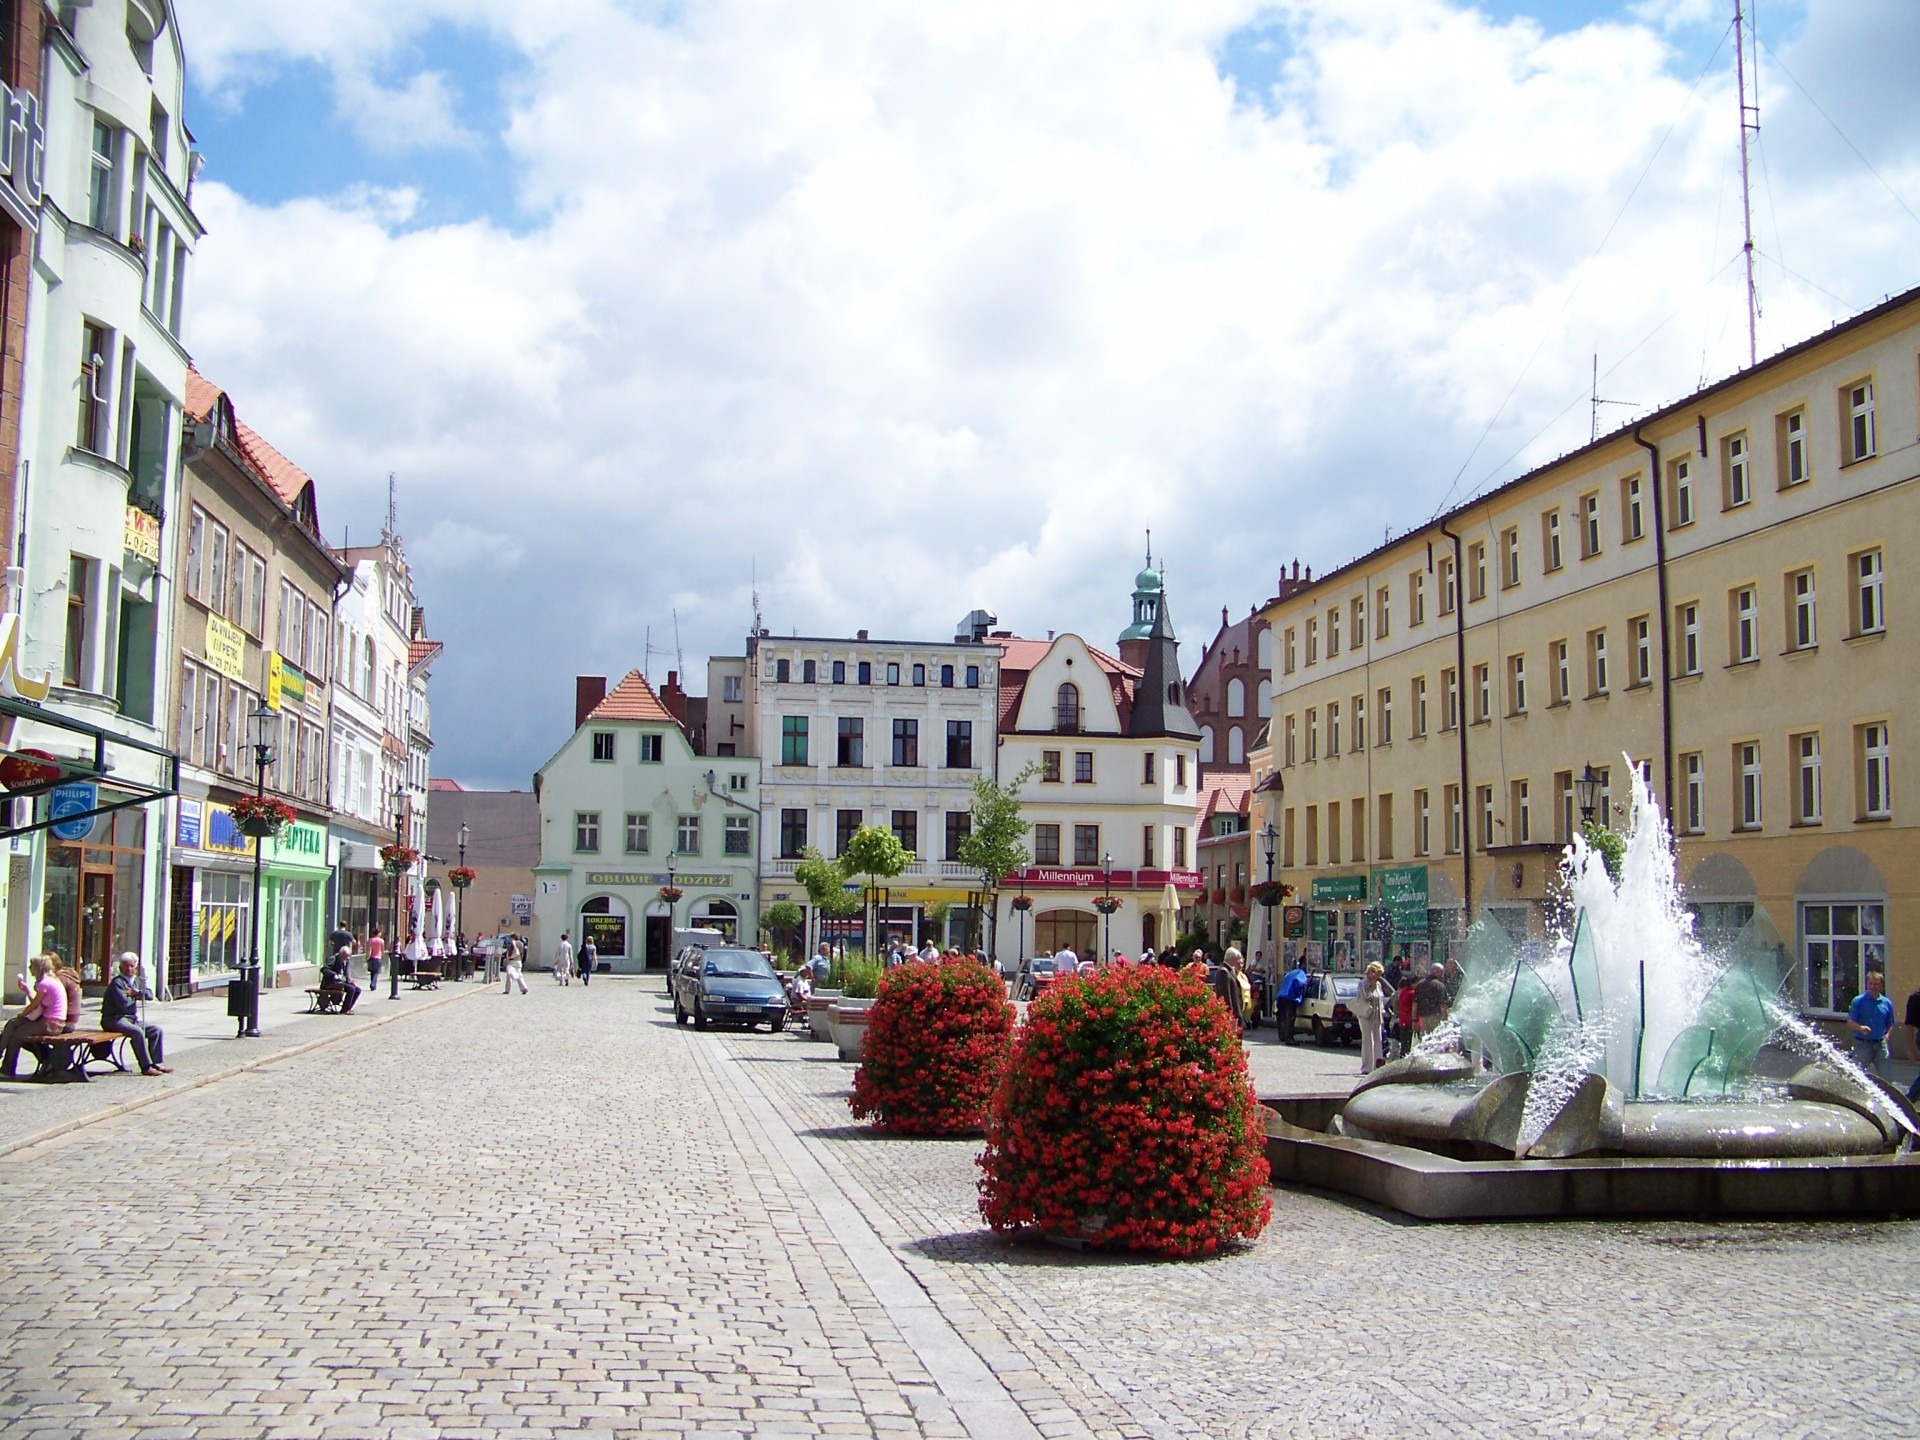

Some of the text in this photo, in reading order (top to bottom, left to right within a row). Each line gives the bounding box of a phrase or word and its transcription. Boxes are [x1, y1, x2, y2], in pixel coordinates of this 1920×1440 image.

[55, 789, 91, 799] PHILIPS
[286, 825, 320, 855] APTEKA
[591, 874, 653, 884] OBUWIE
[1038, 869, 1094, 881] Millennium
[1169, 871, 1199, 884] Millennium
